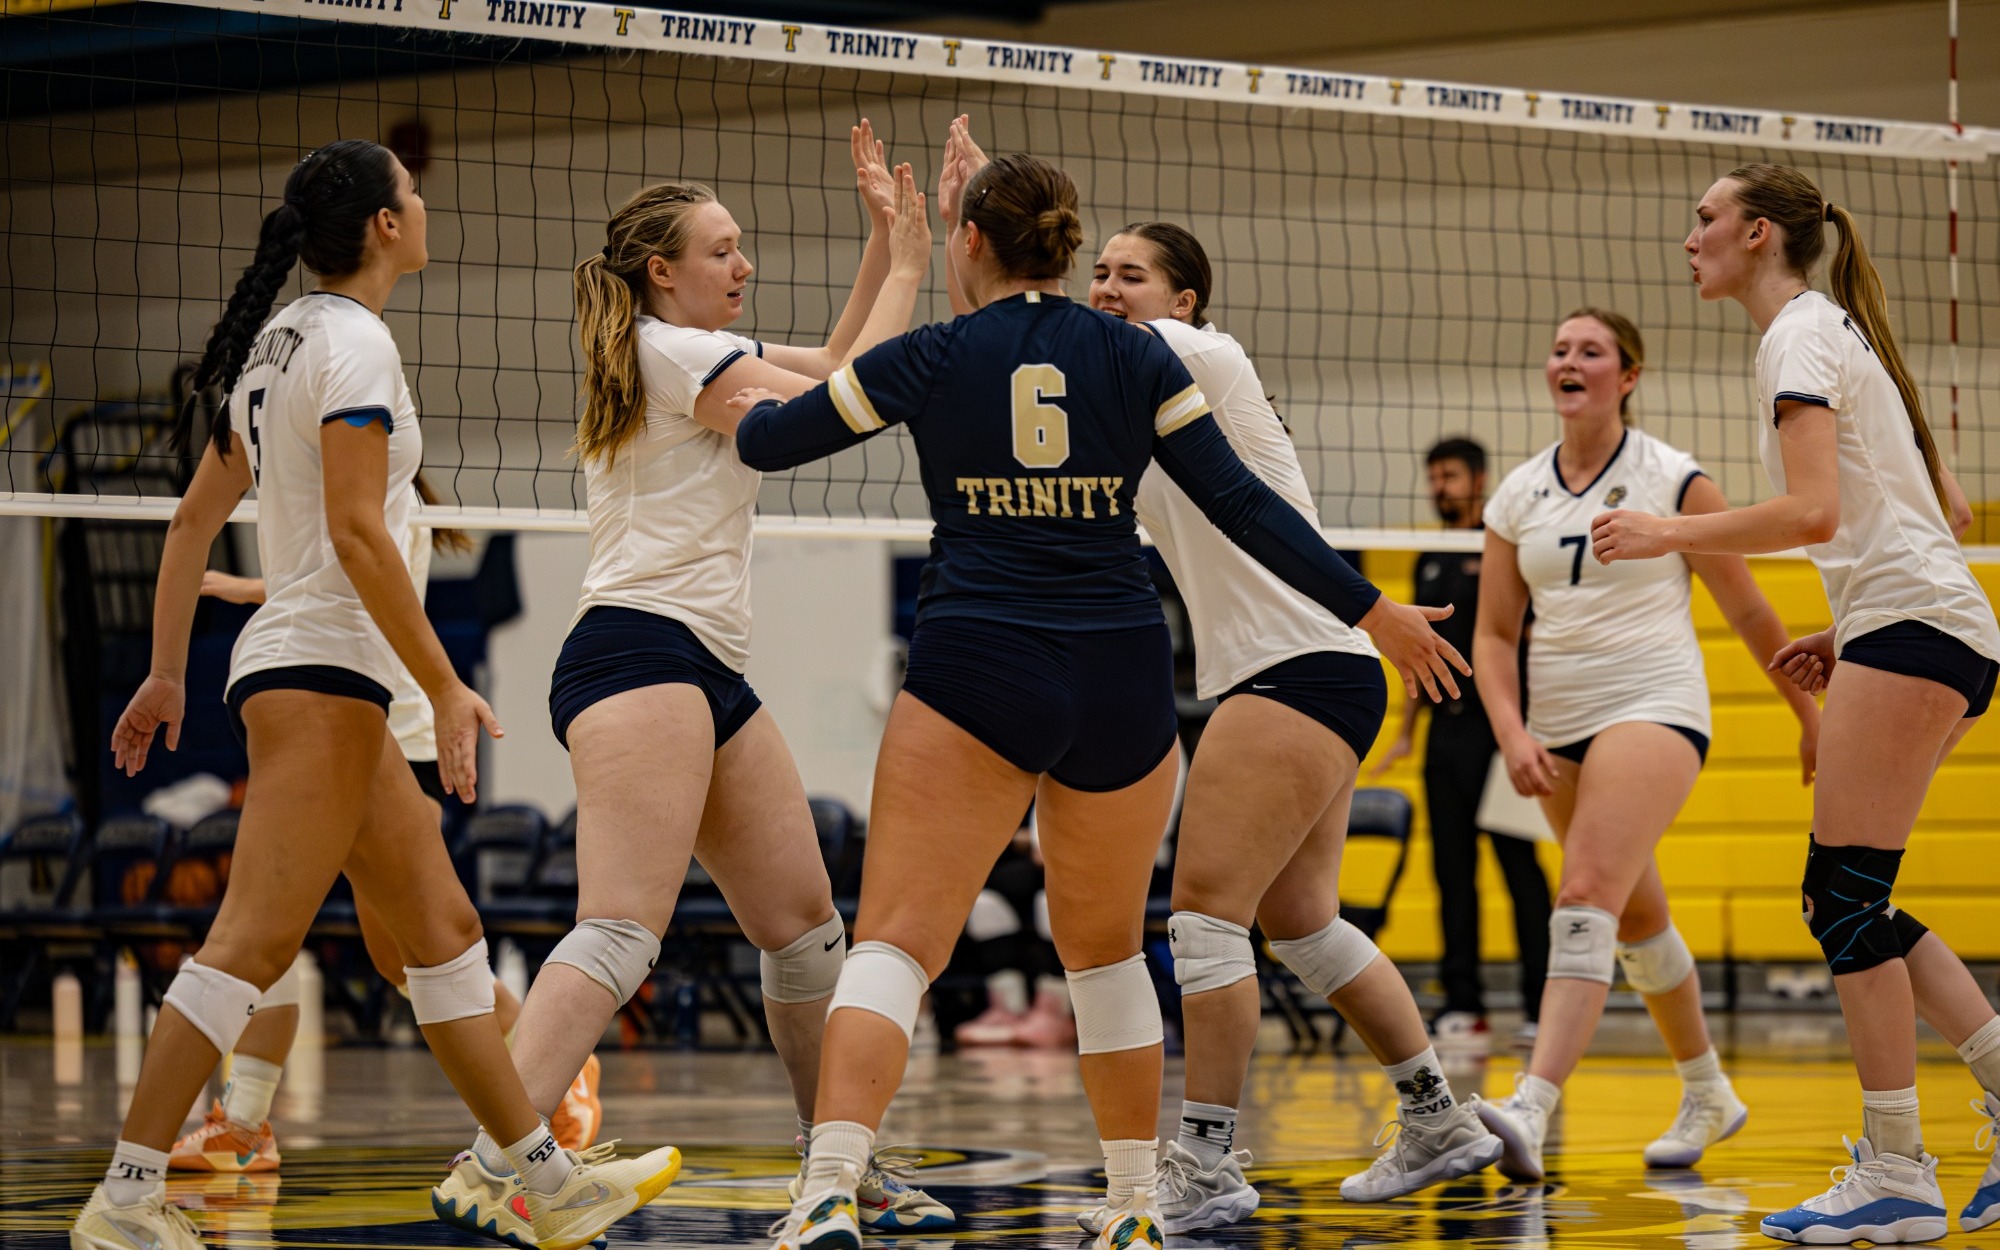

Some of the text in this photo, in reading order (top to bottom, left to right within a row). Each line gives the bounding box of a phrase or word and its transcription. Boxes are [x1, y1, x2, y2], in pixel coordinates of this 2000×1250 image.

[487, 1, 586, 29] TRINITY
[614, 7, 636, 36] T
[661, 14, 756, 45] TRINITY
[782, 24, 802, 52] T
[826, 31, 918, 60] TRINITY
[943, 40, 962, 66] T
[987, 46, 1073, 74] TRINITY
[1098, 54, 1116, 80] T
[1140, 60, 1223, 88] TRINITY
[1245, 69, 1264, 94] T
[1287, 74, 1366, 100] TRINITY
[1389, 81, 1404, 106] T
[1427, 86, 1502, 112] TRINITY
[1524, 92, 1541, 118] T
[1561, 98, 1634, 124] TRINITY
[1692, 110, 1761, 135] TRINITY
[1815, 120, 1884, 145] TRINITY
[246, 327, 304, 374] RINITY
[249, 388, 266, 488] 5
[1011, 363, 1070, 469] 6
[956, 477, 1124, 519] TRINITY
[1559, 535, 1588, 586] 7
[526, 1135, 556, 1162] T
